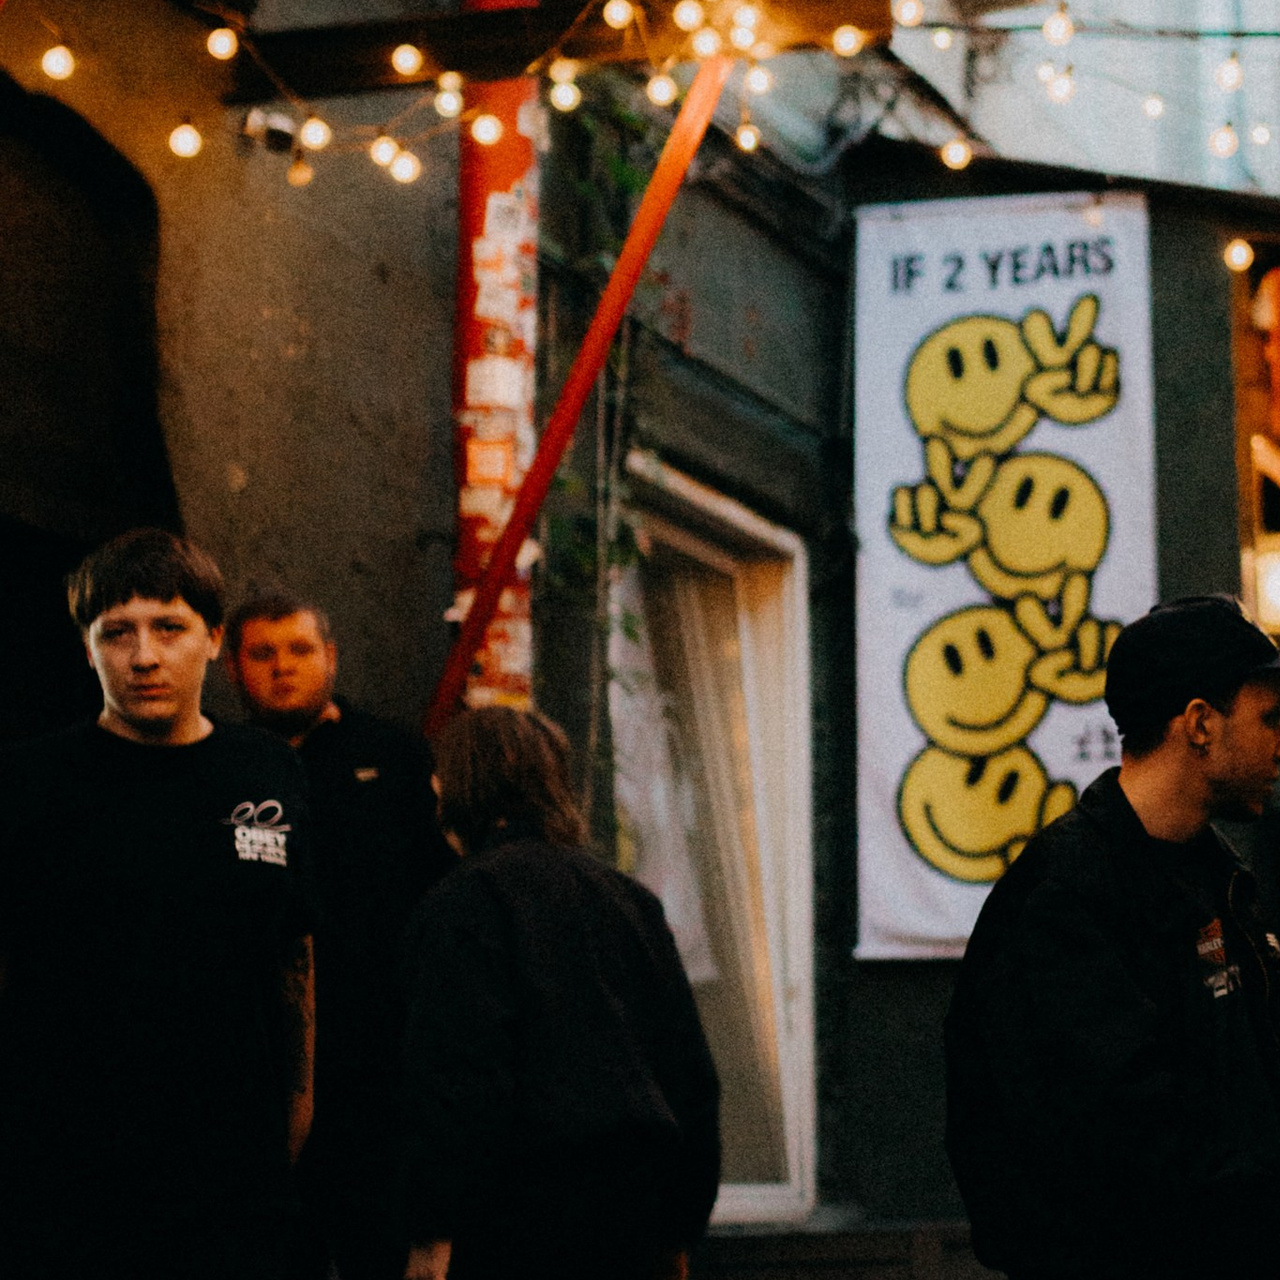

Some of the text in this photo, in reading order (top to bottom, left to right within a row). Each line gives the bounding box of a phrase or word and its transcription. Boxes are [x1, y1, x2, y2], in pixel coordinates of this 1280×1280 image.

[891, 237, 1115, 293] IF 2 YEARS
